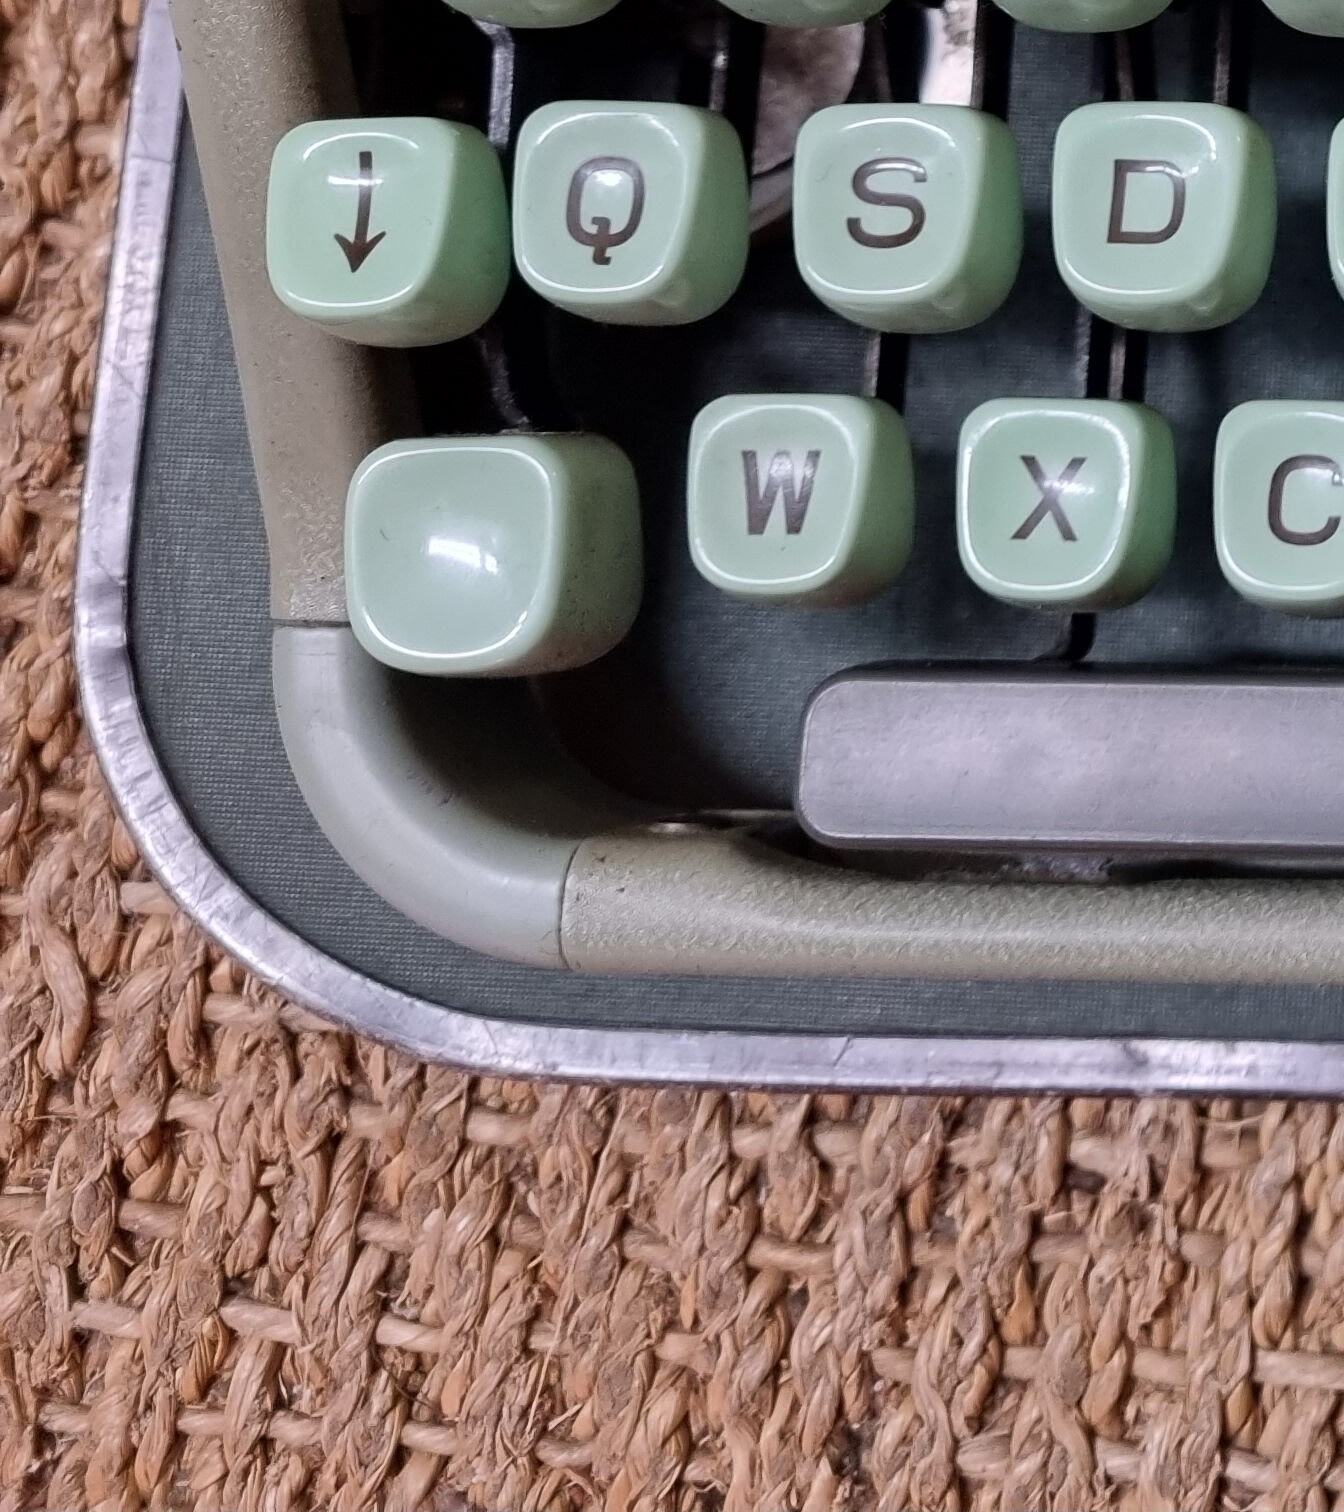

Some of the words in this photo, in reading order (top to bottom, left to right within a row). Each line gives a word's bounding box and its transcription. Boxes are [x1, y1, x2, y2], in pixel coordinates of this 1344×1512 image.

[565, 155, 646, 267] Q
[846, 156, 926, 249] S
[1106, 157, 1186, 245] D
[741, 449, 821, 536] W
[1010, 454, 1087, 542] X
[1267, 454, 1341, 547] C
